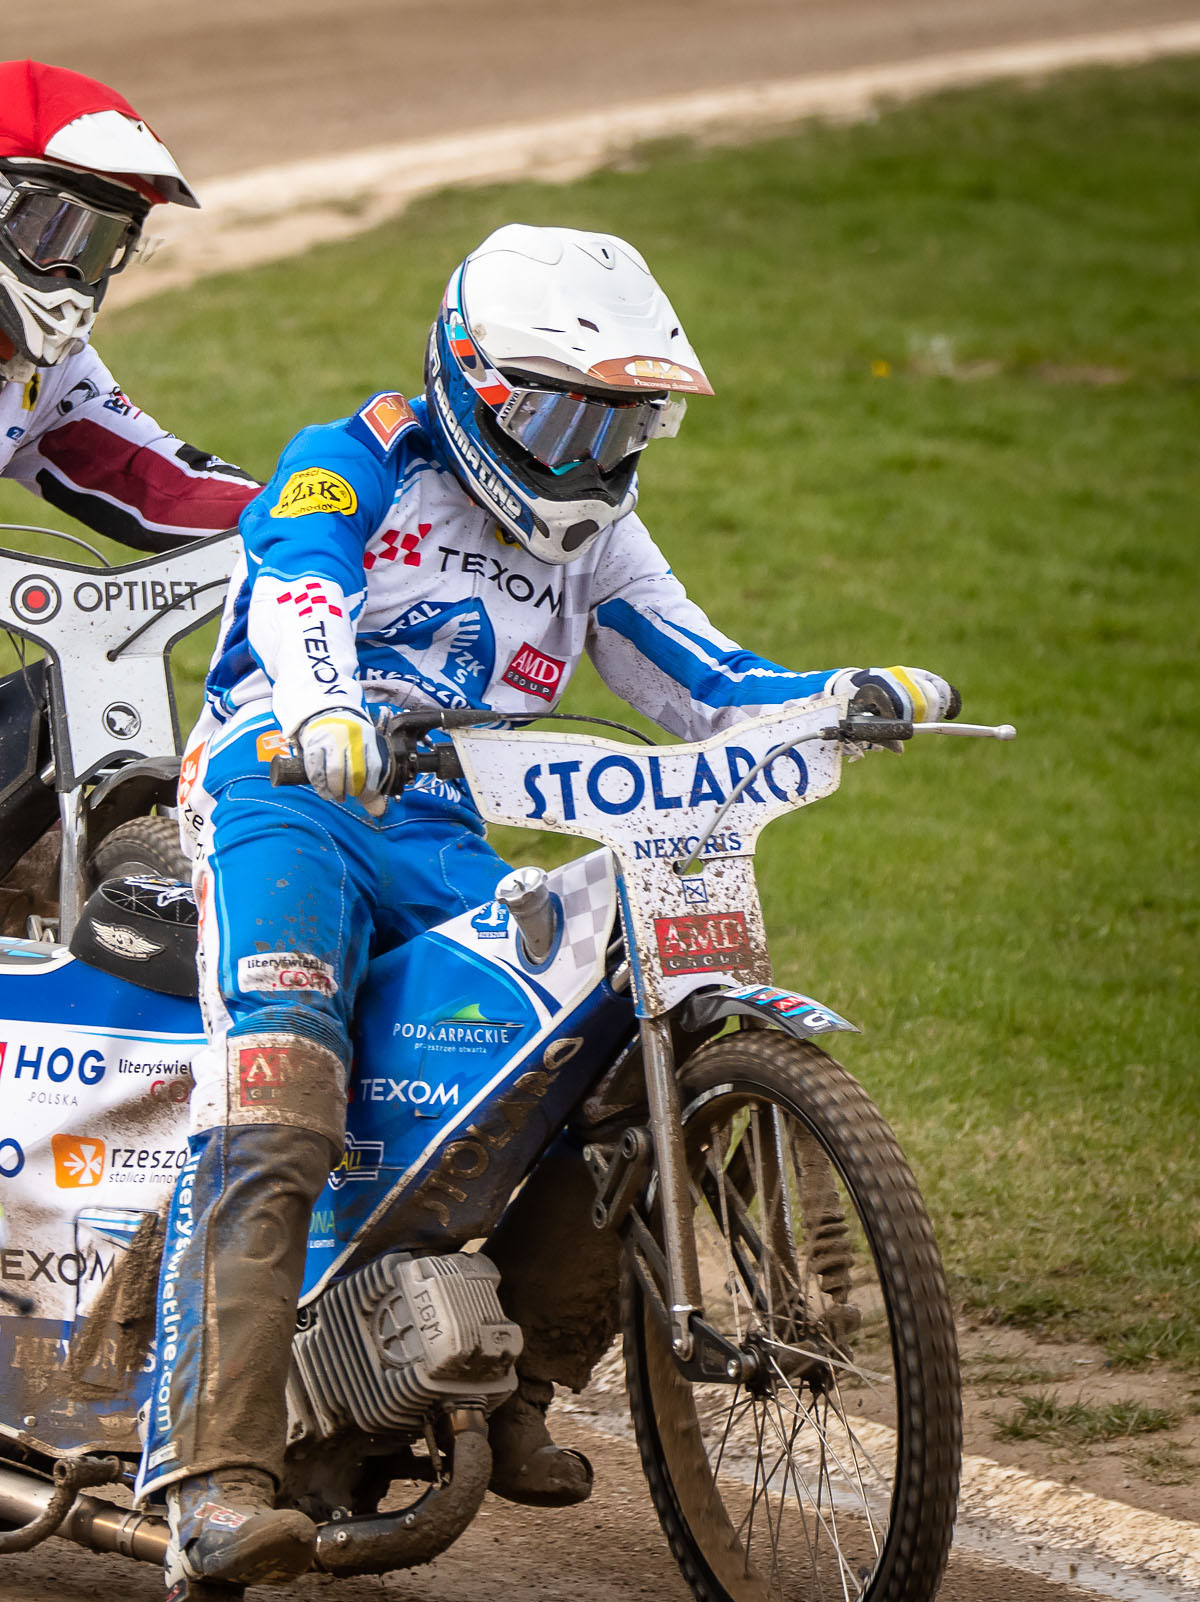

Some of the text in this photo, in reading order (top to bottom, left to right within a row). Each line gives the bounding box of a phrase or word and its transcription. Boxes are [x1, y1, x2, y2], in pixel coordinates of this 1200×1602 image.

[439, 546, 564, 618] TEXOM
[74, 581, 197, 612] OPTIBET
[511, 650, 560, 684] AMD
[506, 671, 550, 696] GROUP
[524, 745, 809, 821] STOLARO
[634, 832, 742, 860] NEXORIS
[665, 919, 744, 953] AMD
[393, 1022, 509, 1044] PODKARPACKIE
[14, 1045, 106, 1086] HOG
[28, 1090, 80, 1108] POLSKA
[361, 1078, 460, 1106] TEXOM
[111, 1147, 188, 1170] rzeszó
[108, 1172, 146, 1185] stolica
